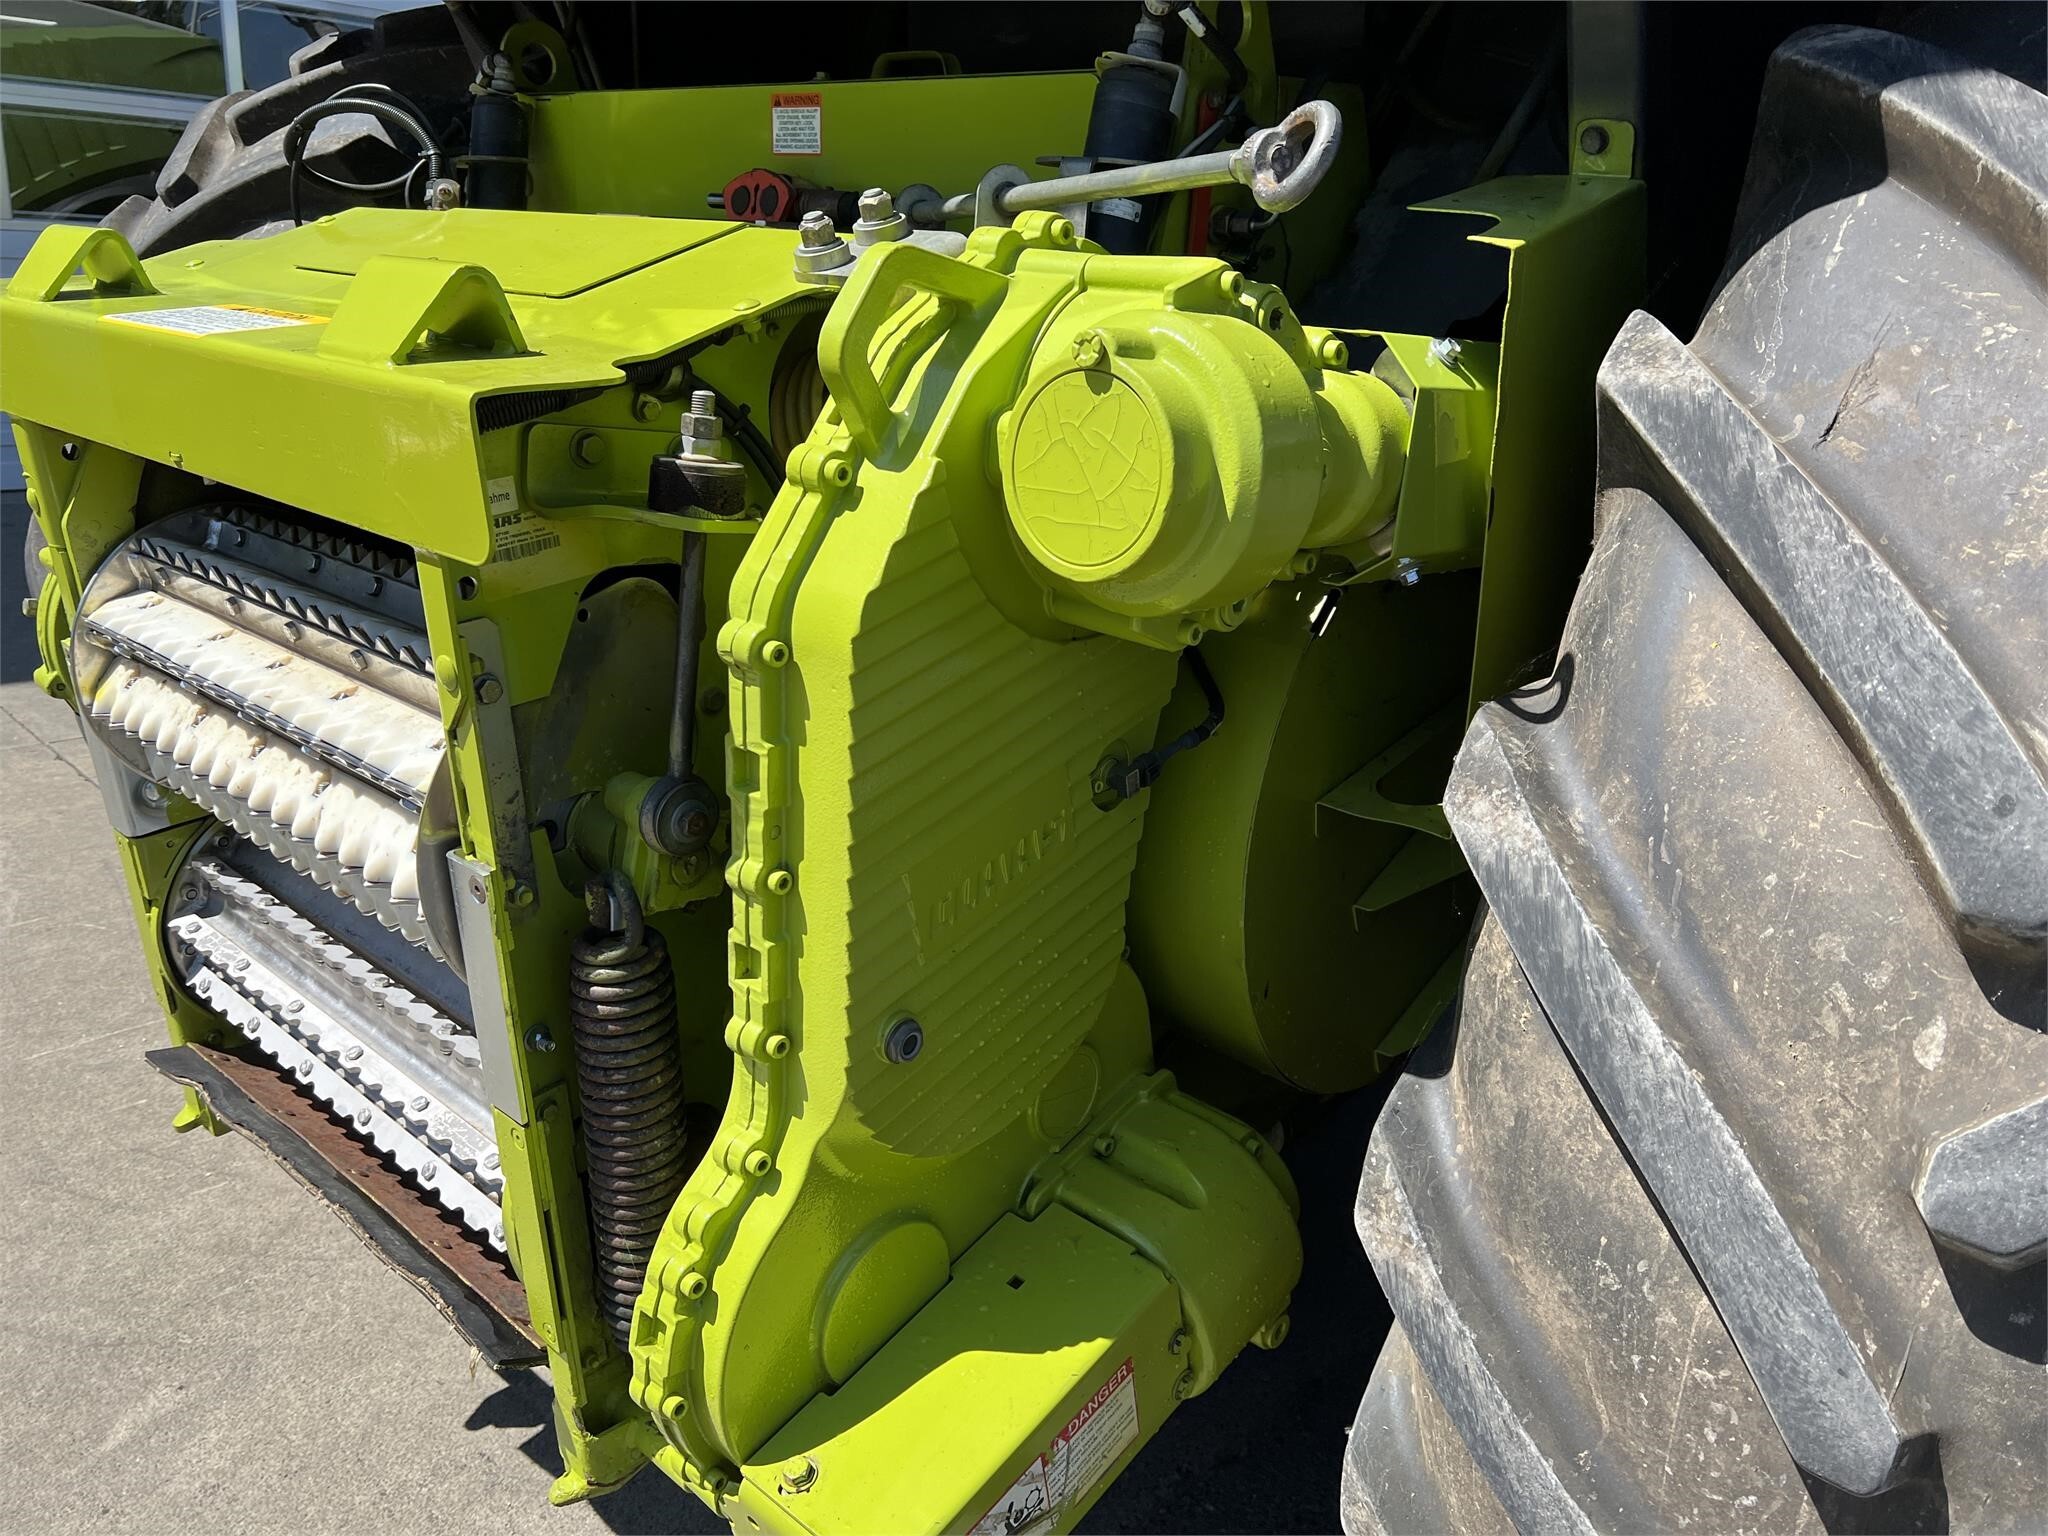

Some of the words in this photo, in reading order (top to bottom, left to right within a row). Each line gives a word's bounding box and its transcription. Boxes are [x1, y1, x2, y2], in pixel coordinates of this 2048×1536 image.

[782, 95, 819, 105] WARNING
[489, 492, 510, 504] ahme
[1068, 1364, 1128, 1437] DANGER
